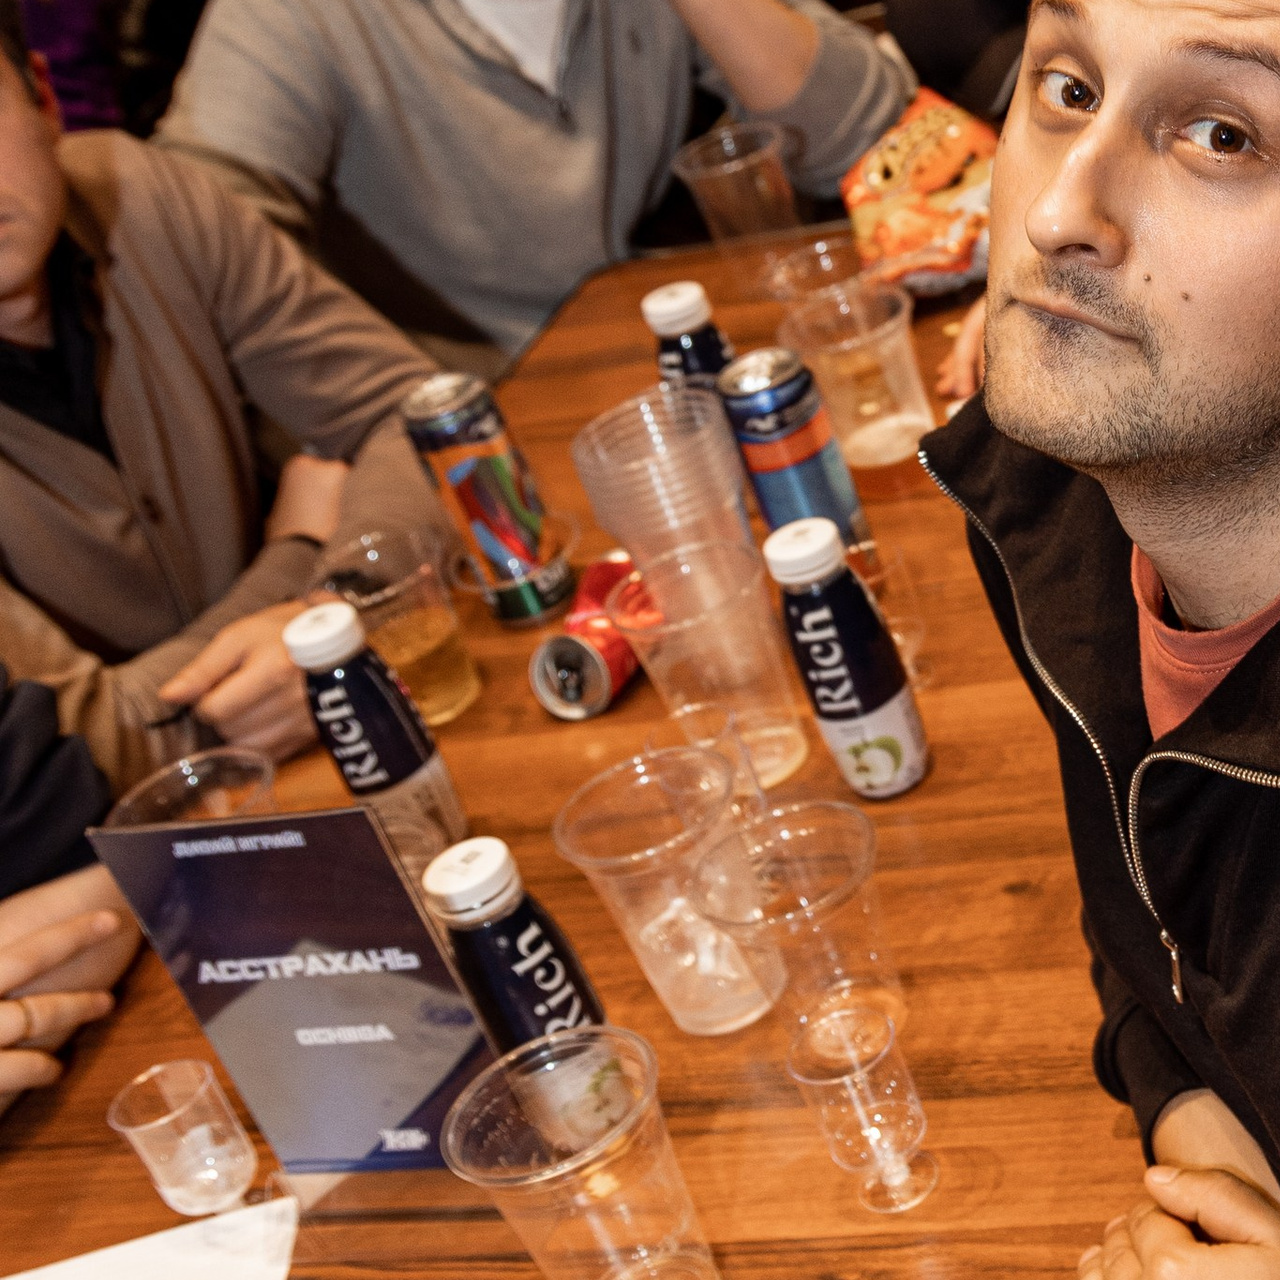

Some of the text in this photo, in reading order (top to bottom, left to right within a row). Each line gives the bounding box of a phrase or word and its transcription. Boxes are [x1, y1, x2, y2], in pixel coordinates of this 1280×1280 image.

[795, 605, 862, 713] Rich
[315, 685, 390, 788] Rich
[198, 946, 421, 984] АССТРАХАНЬ
